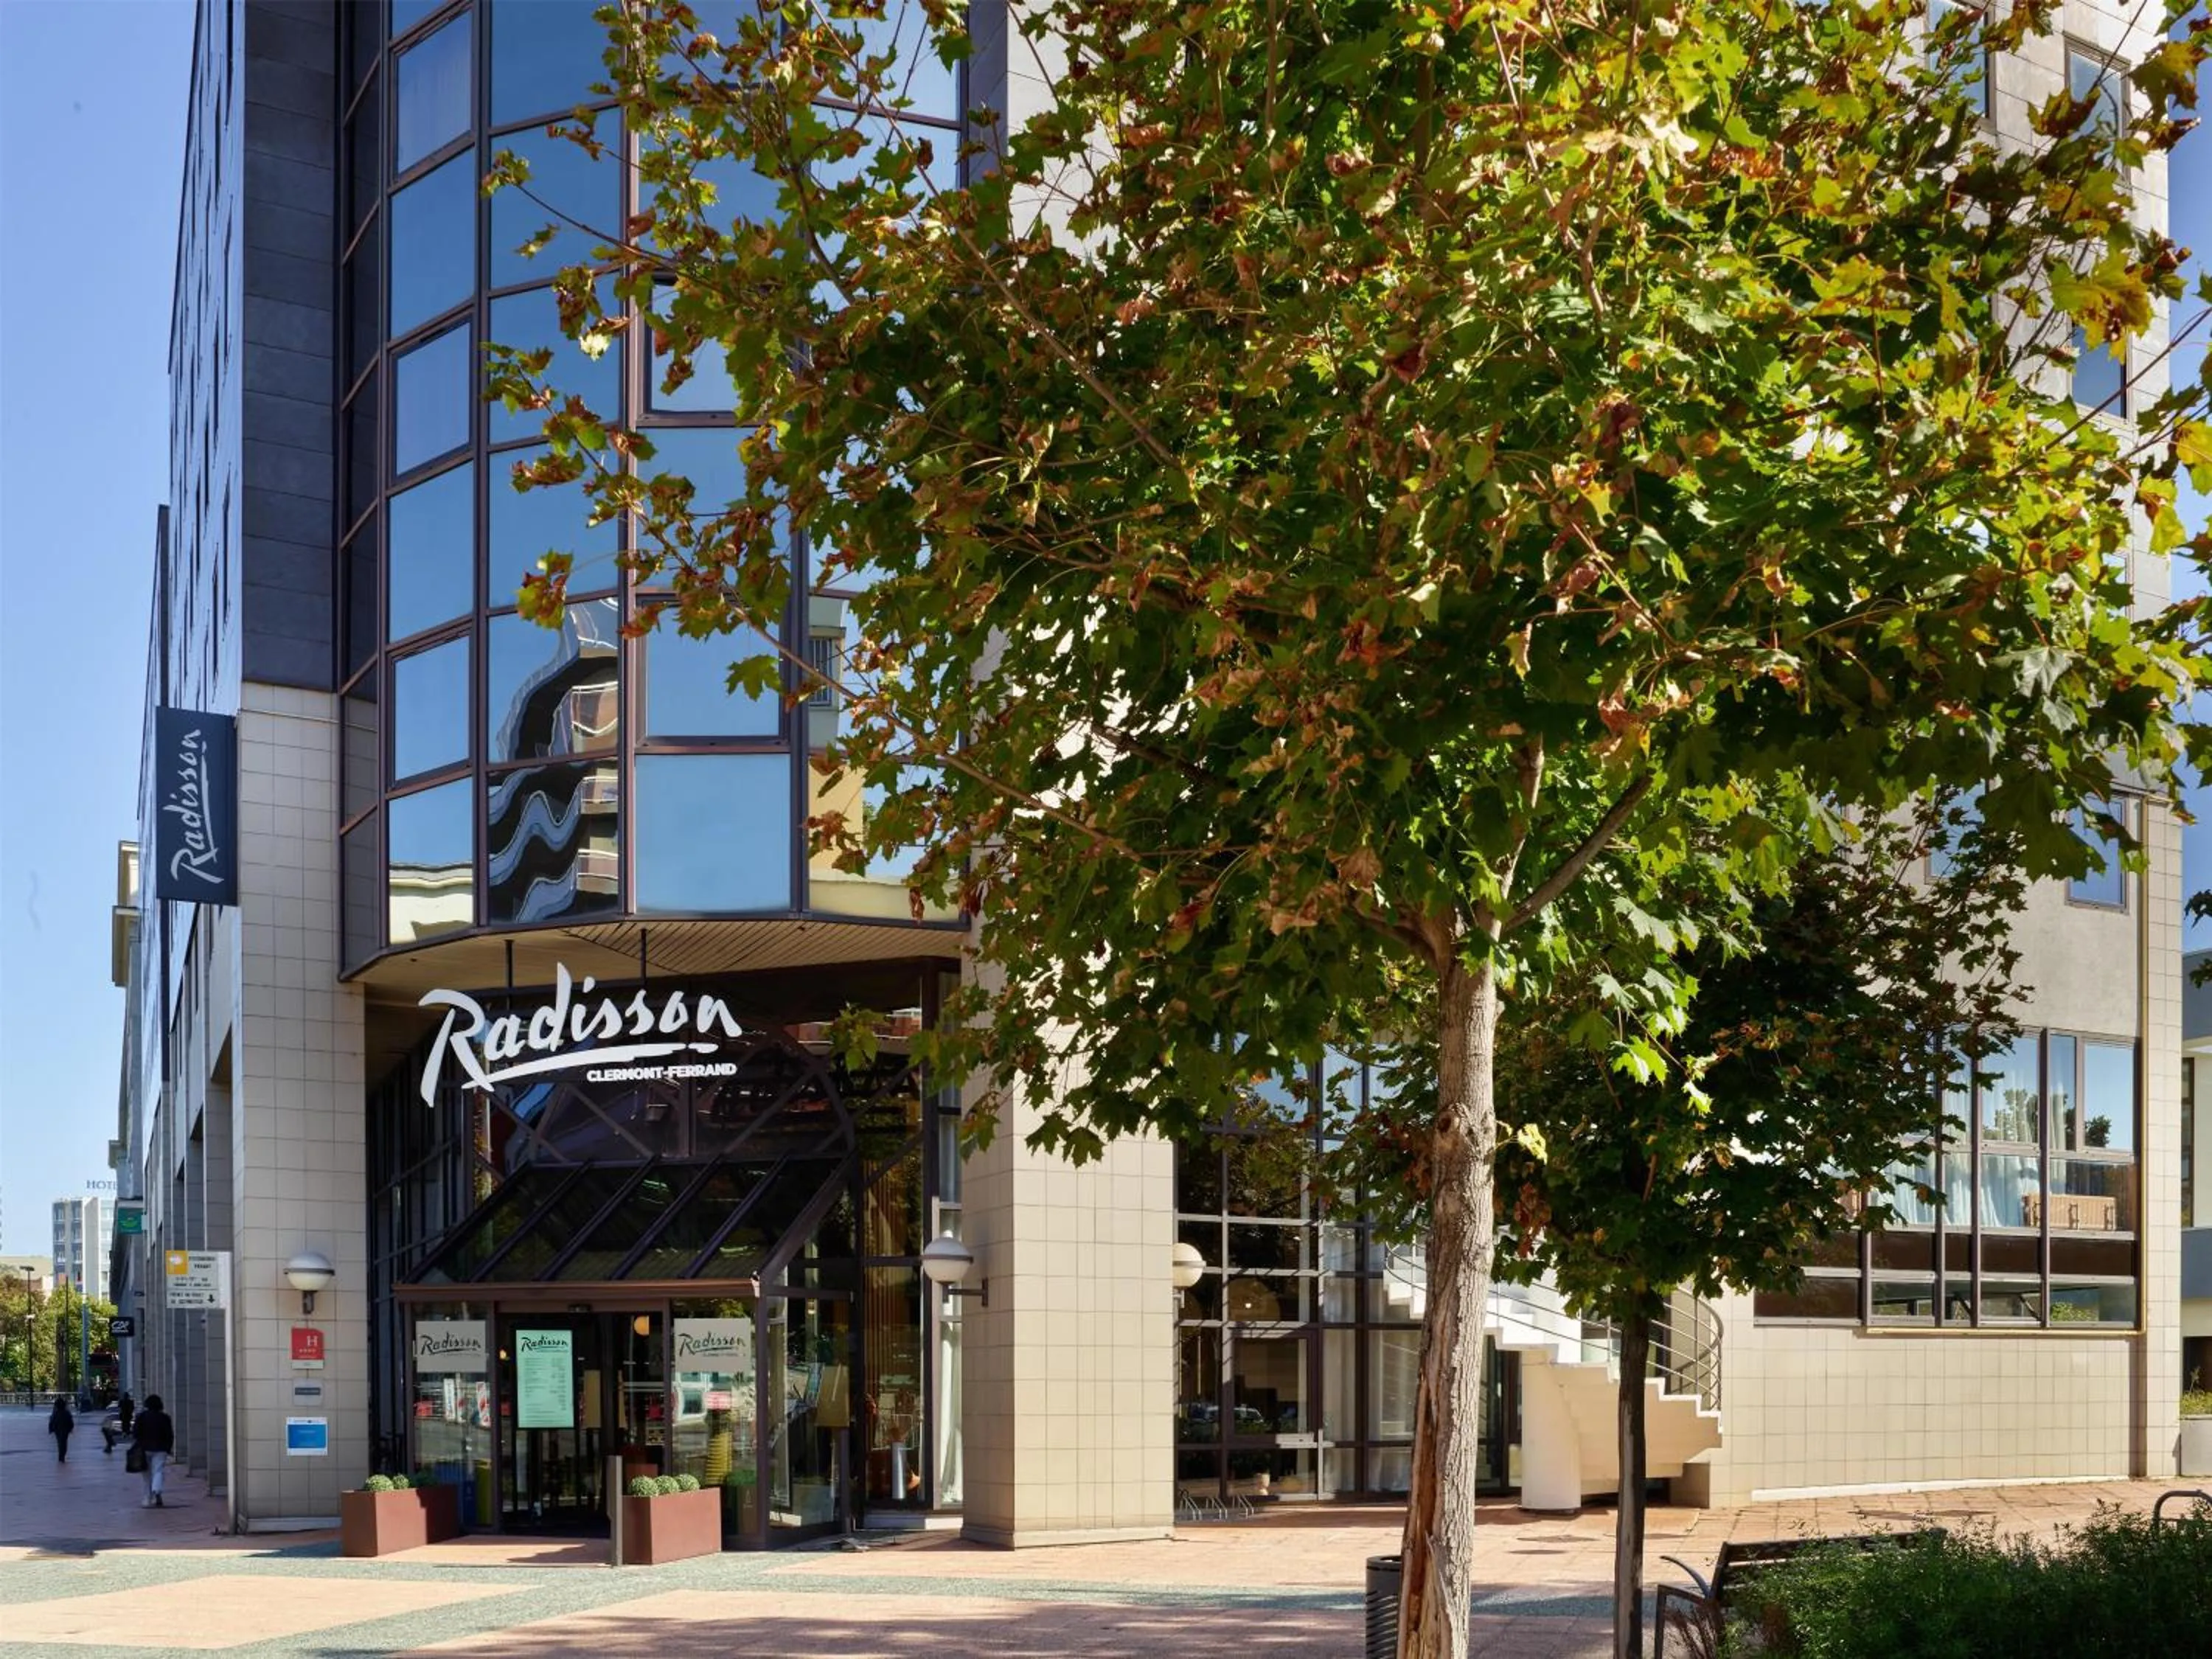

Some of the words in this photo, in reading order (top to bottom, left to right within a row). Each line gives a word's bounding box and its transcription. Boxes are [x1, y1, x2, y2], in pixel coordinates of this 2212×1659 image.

[162, 728, 224, 884] Radisson
[418, 961, 742, 1107] Radisson
[587, 1063, 737, 1082] CLERMONT-FERRAND
[307, 1335, 318, 1346] H
[420, 1331, 481, 1355] Radisson
[521, 1335, 568, 1352] Radisson
[678, 1331, 745, 1357] Radisson
